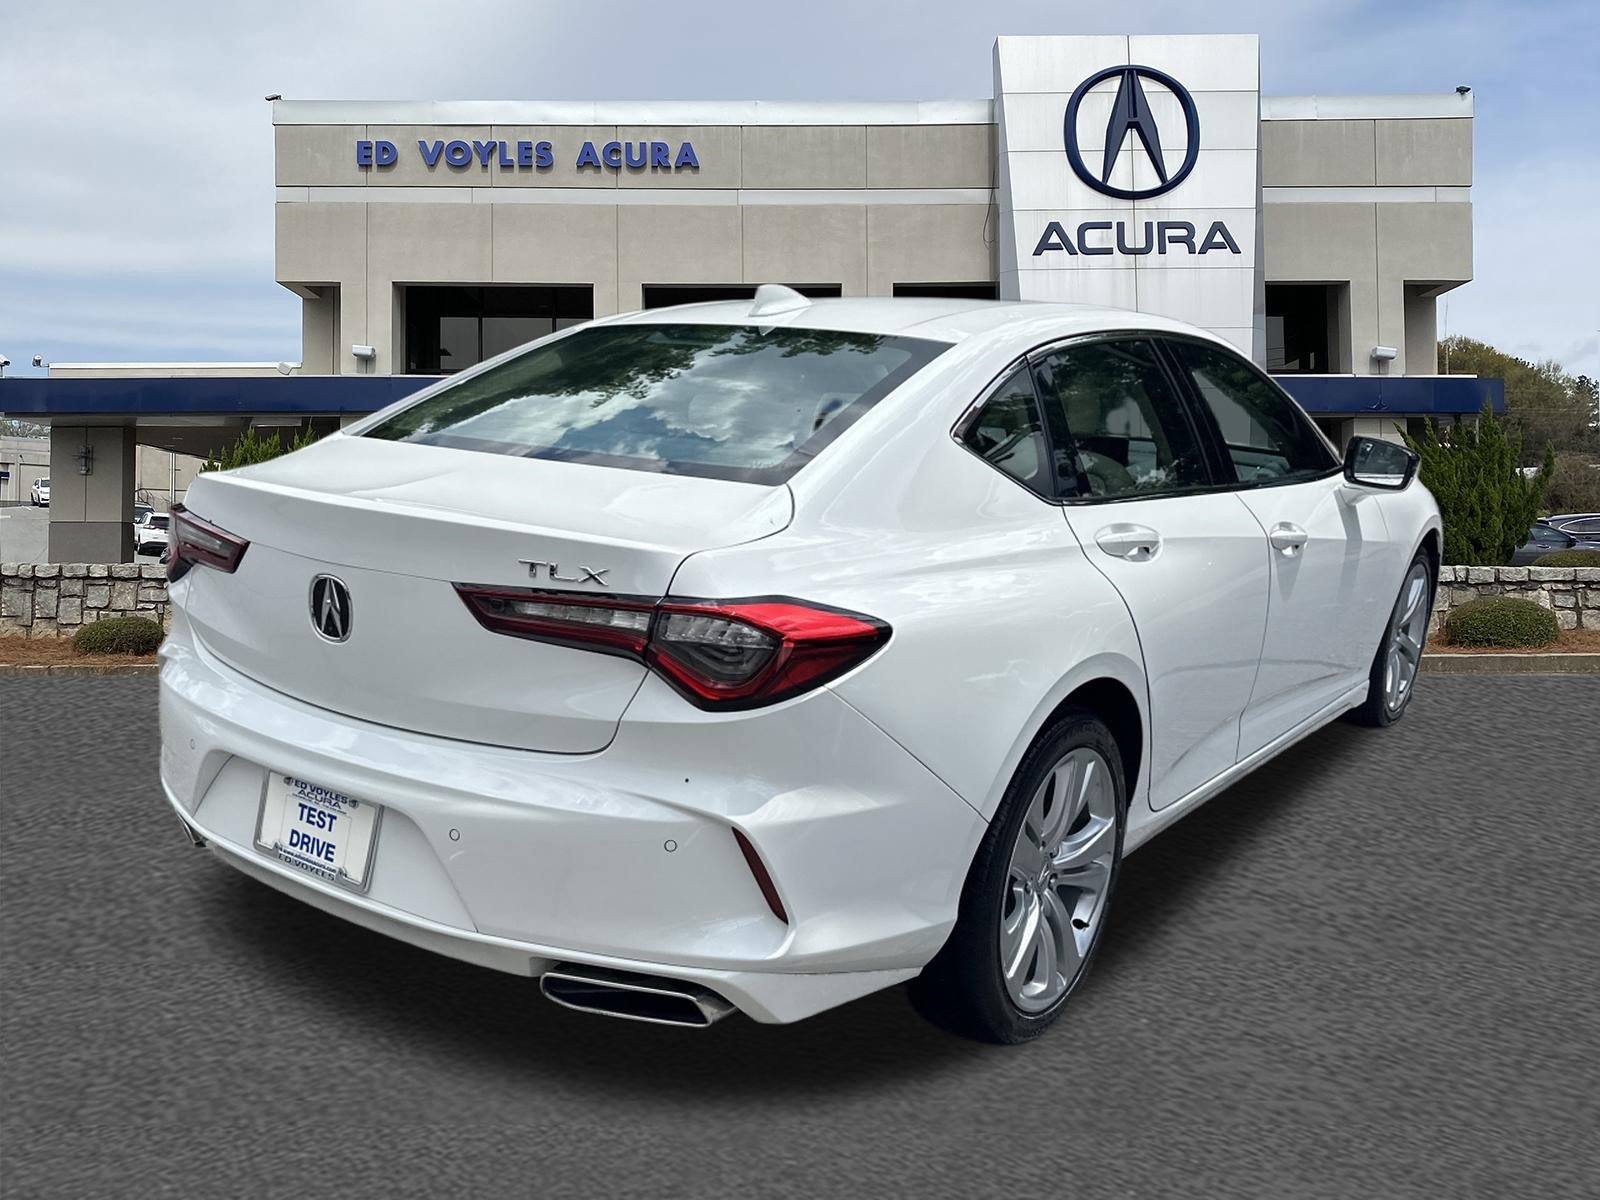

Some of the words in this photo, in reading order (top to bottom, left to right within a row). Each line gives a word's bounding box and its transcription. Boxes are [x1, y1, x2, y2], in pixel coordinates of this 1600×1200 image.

[356, 140, 398, 168] ED
[418, 140, 554, 169] VOYLES
[575, 141, 701, 169] ACURA
[1032, 221, 1242, 256] ACURA
[518, 558, 611, 587] TLX
[298, 789, 342, 810] ACURA
[309, 785, 348, 804] VOYLES
[298, 802, 337, 832] TEST
[278, 853, 293, 864] ED
[289, 829, 336, 862] DRIVE
